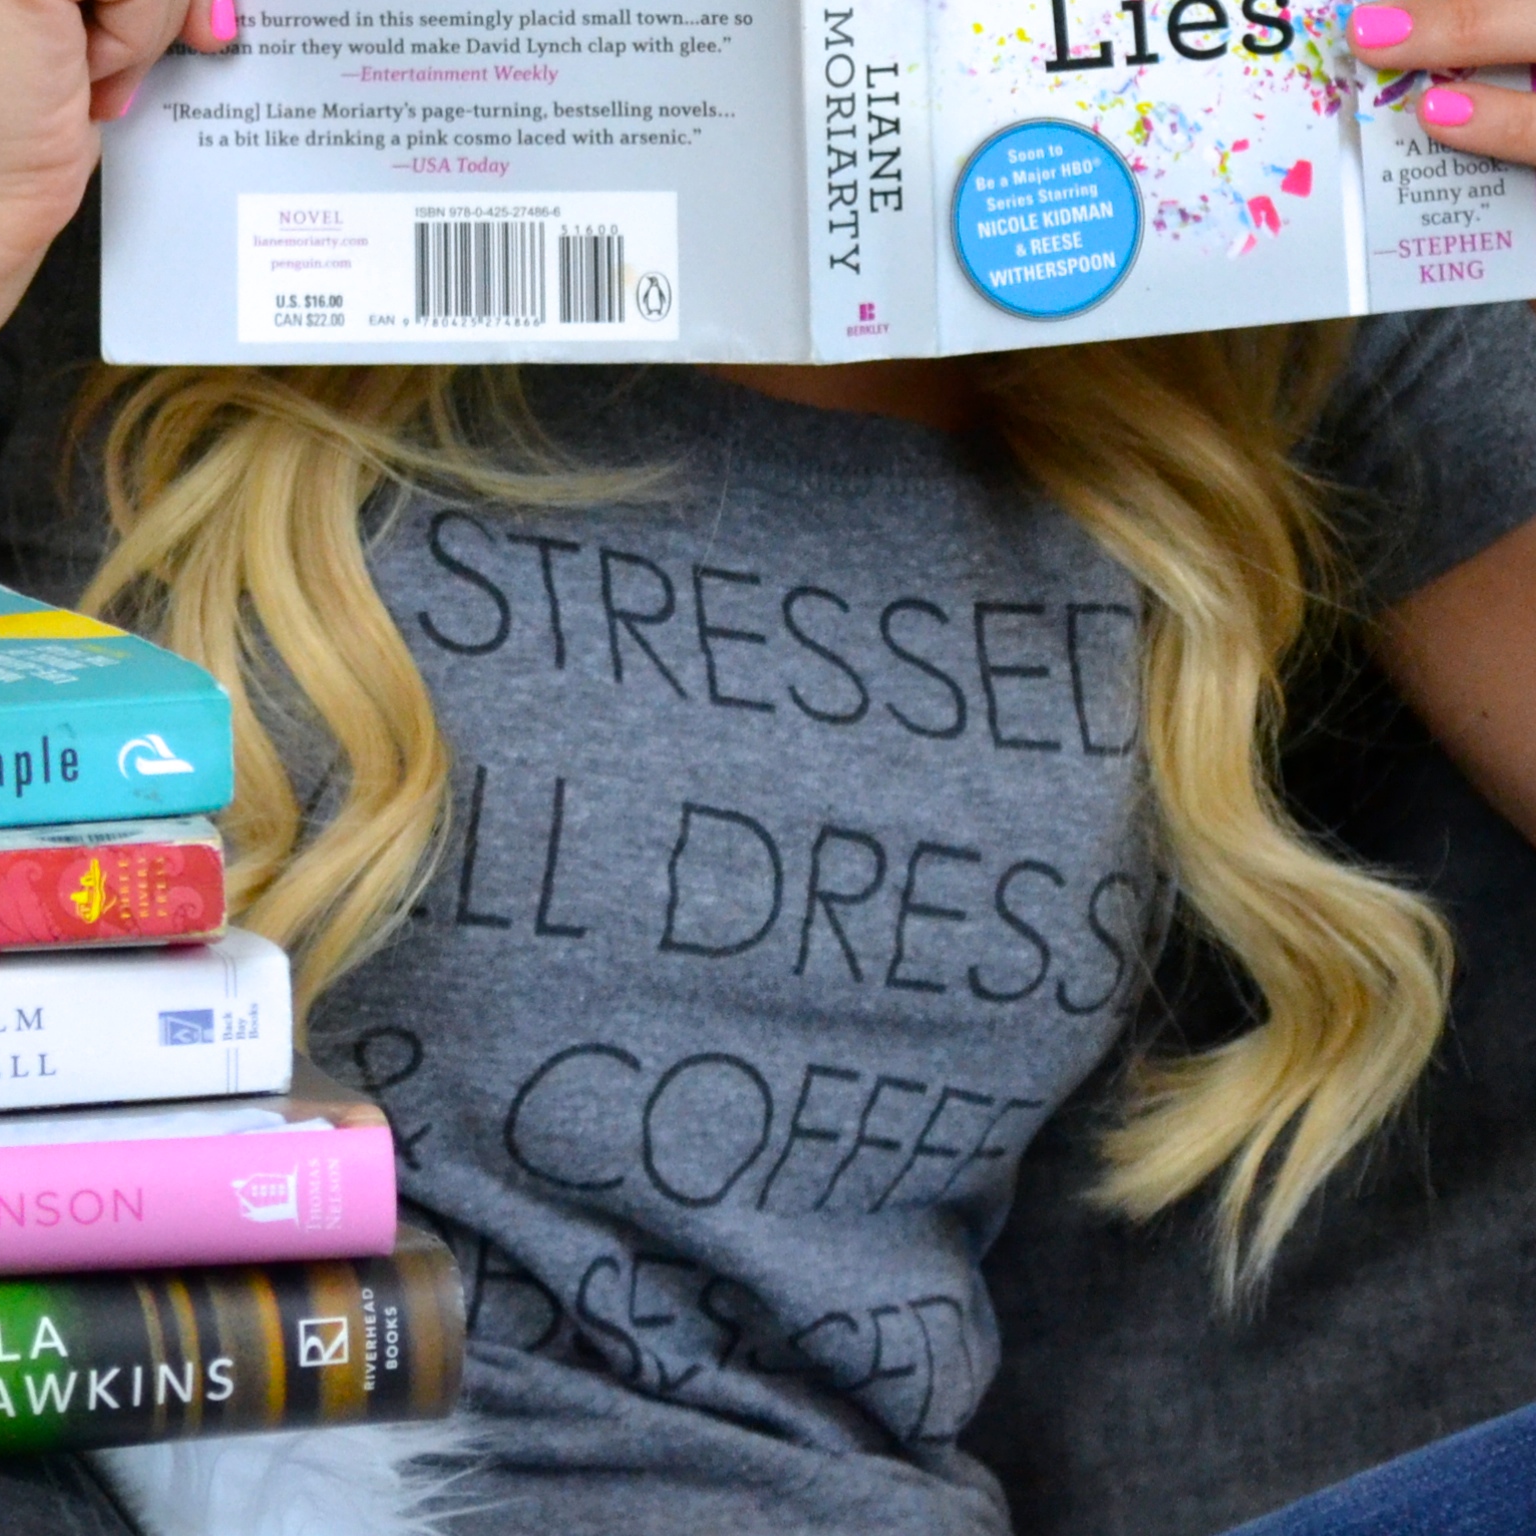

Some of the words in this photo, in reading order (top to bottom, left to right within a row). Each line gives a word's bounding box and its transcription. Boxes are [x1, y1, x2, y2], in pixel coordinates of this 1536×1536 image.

[493, 63, 559, 86] Weekly
[824, 8, 861, 275] MORIARTY
[866, 63, 903, 213] LIANE
[456, 155, 511, 178] Today
[1007, 148, 1045, 164] Soon
[1048, 144, 1063, 158] to
[976, 175, 995, 191] Be
[999, 174, 1009, 186] a
[1013, 167, 1057, 185] Major
[1382, 168, 1393, 183] a
[1399, 159, 1447, 185] good
[1453, 156, 1510, 177] book.
[986, 192, 1034, 212] Series
[1038, 183, 1098, 206] Starring
[1398, 184, 1462, 206] Funny
[1468, 178, 1506, 198] and
[279, 210, 344, 226] NOVEL
[415, 207, 445, 218] ISBN
[977, 215, 1038, 239] NICOLE
[1042, 201, 1114, 226] KIDMAN
[253, 235, 369, 250] lianemoriarty.com
[1015, 243, 1027, 257] &
[1030, 231, 1083, 256] REESE
[271, 256, 352, 272] penguin.com
[989, 251, 1117, 288] WITHERSPOON
[1419, 260, 1485, 284] KING
[276, 295, 301, 309] U.S.
[305, 294, 344, 309] $16.00
[274, 313, 303, 327] CAN
[306, 312, 345, 328] $22.00
[369, 315, 395, 326] EAN
[847, 323, 890, 337] BERKLEY
[417, 509, 1139, 755] STRESSED
[222, 1011, 233, 1042] Back
[248, 1002, 260, 1041] Books
[306, 1158, 322, 1234] THOMAS
[326, 1157, 343, 1231] NELSON
[363, 1286, 377, 1392] RIVERHEAD
[385, 1305, 400, 1371] BOOKS
